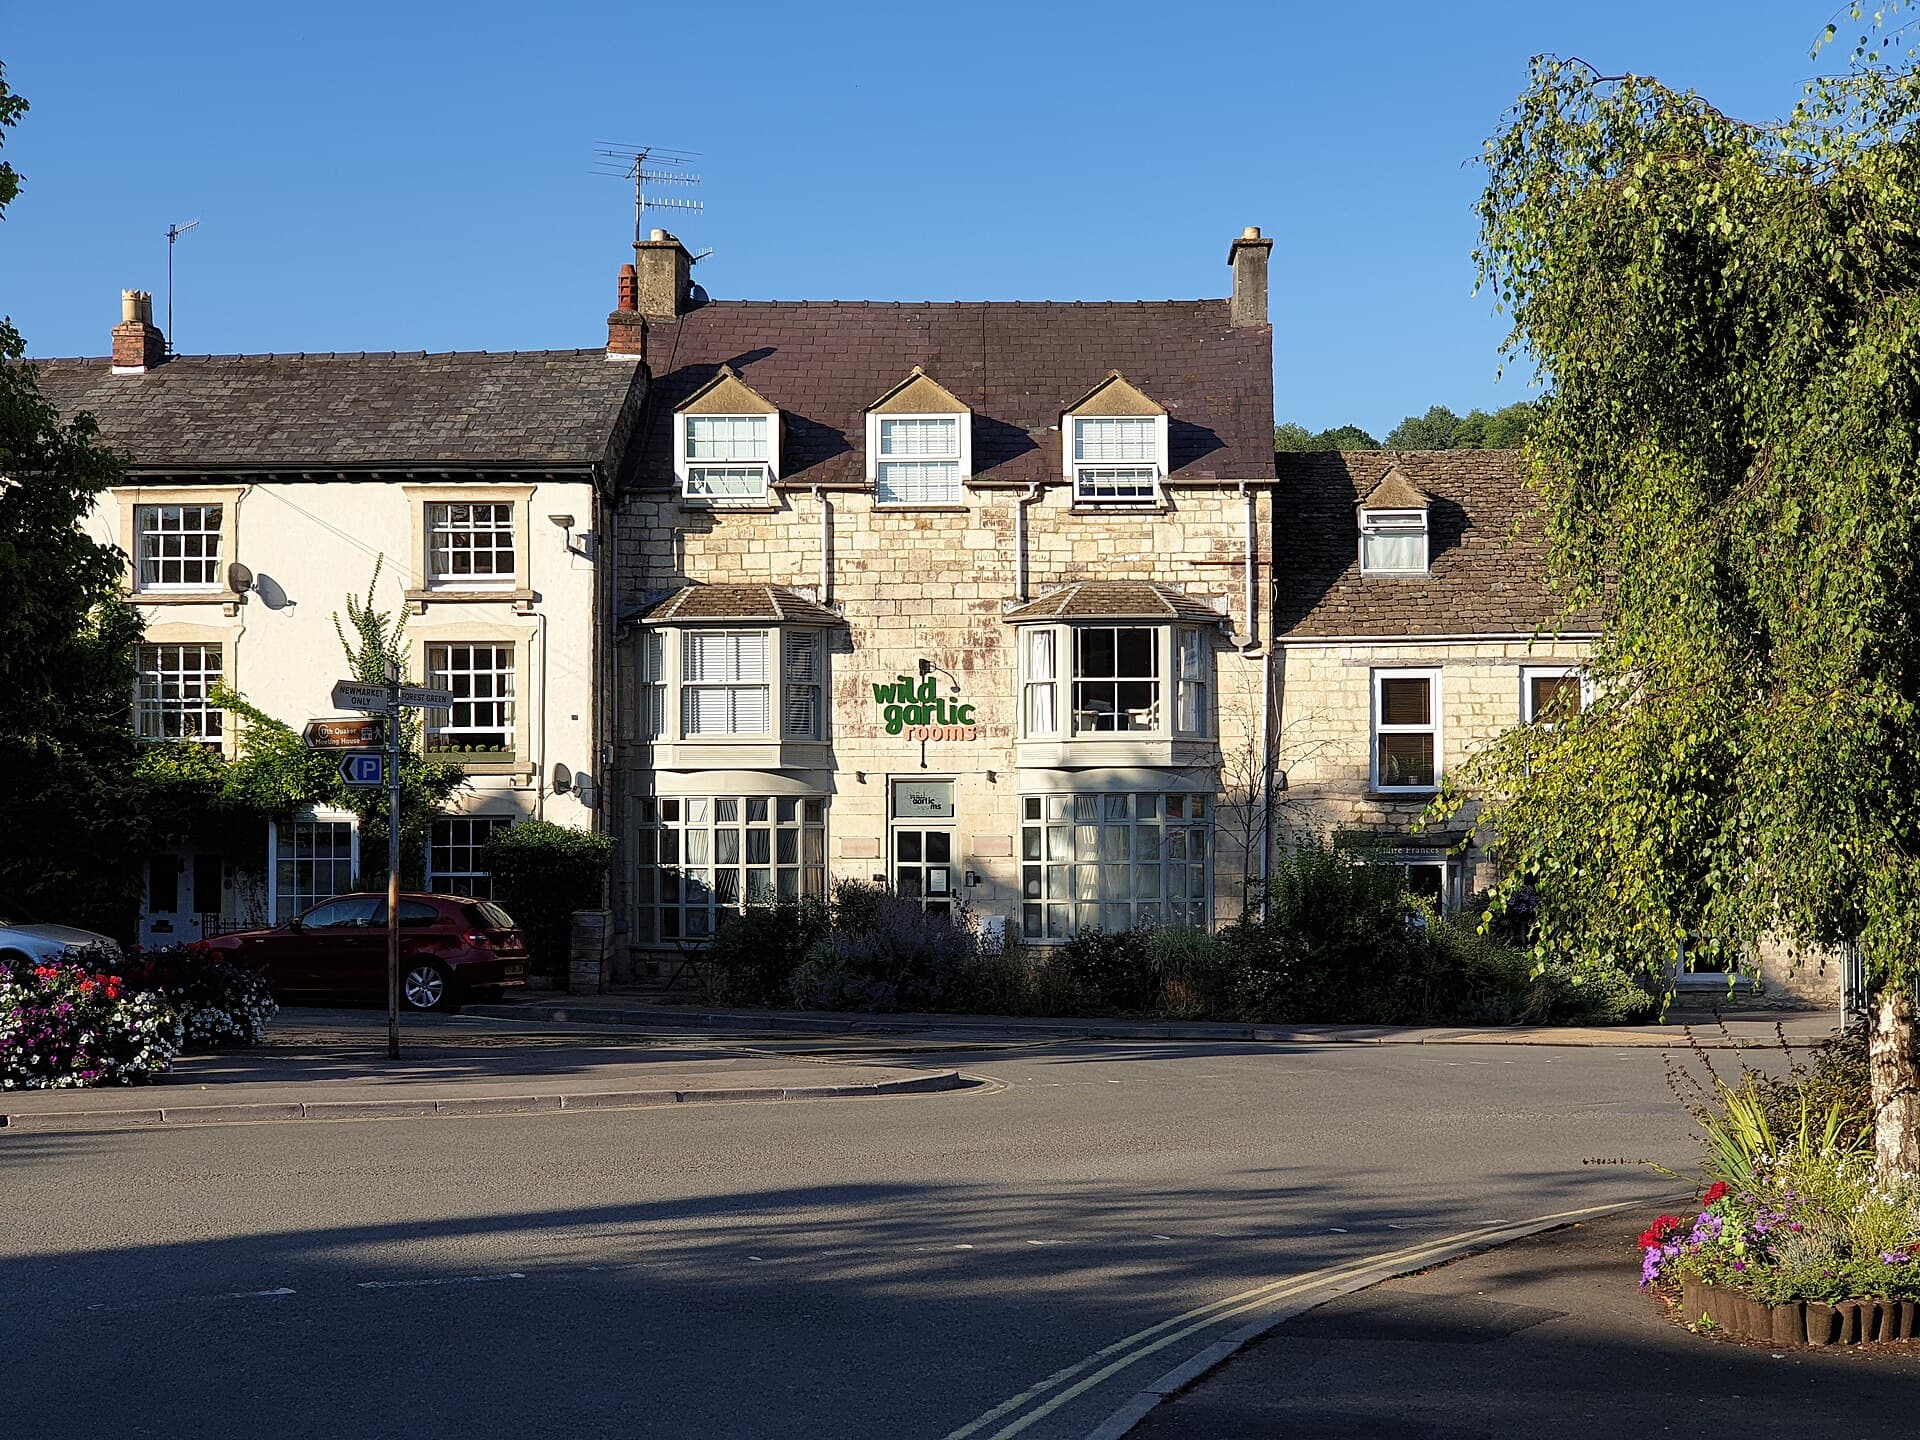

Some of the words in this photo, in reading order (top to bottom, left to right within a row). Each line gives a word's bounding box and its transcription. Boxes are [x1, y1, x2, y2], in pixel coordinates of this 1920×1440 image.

[340, 685, 383, 698] NEWMARKET
[872, 675, 937, 704] wild
[351, 696, 371, 706] ONLY
[402, 691, 425, 701] FOREST
[426, 694, 447, 703] GREEN
[883, 696, 976, 735] garlic
[334, 727, 357, 736] Quaker
[903, 725, 977, 741] rooms
[315, 738, 340, 746] Meeting
[340, 737, 361, 745] House
[362, 760, 377, 779] P
